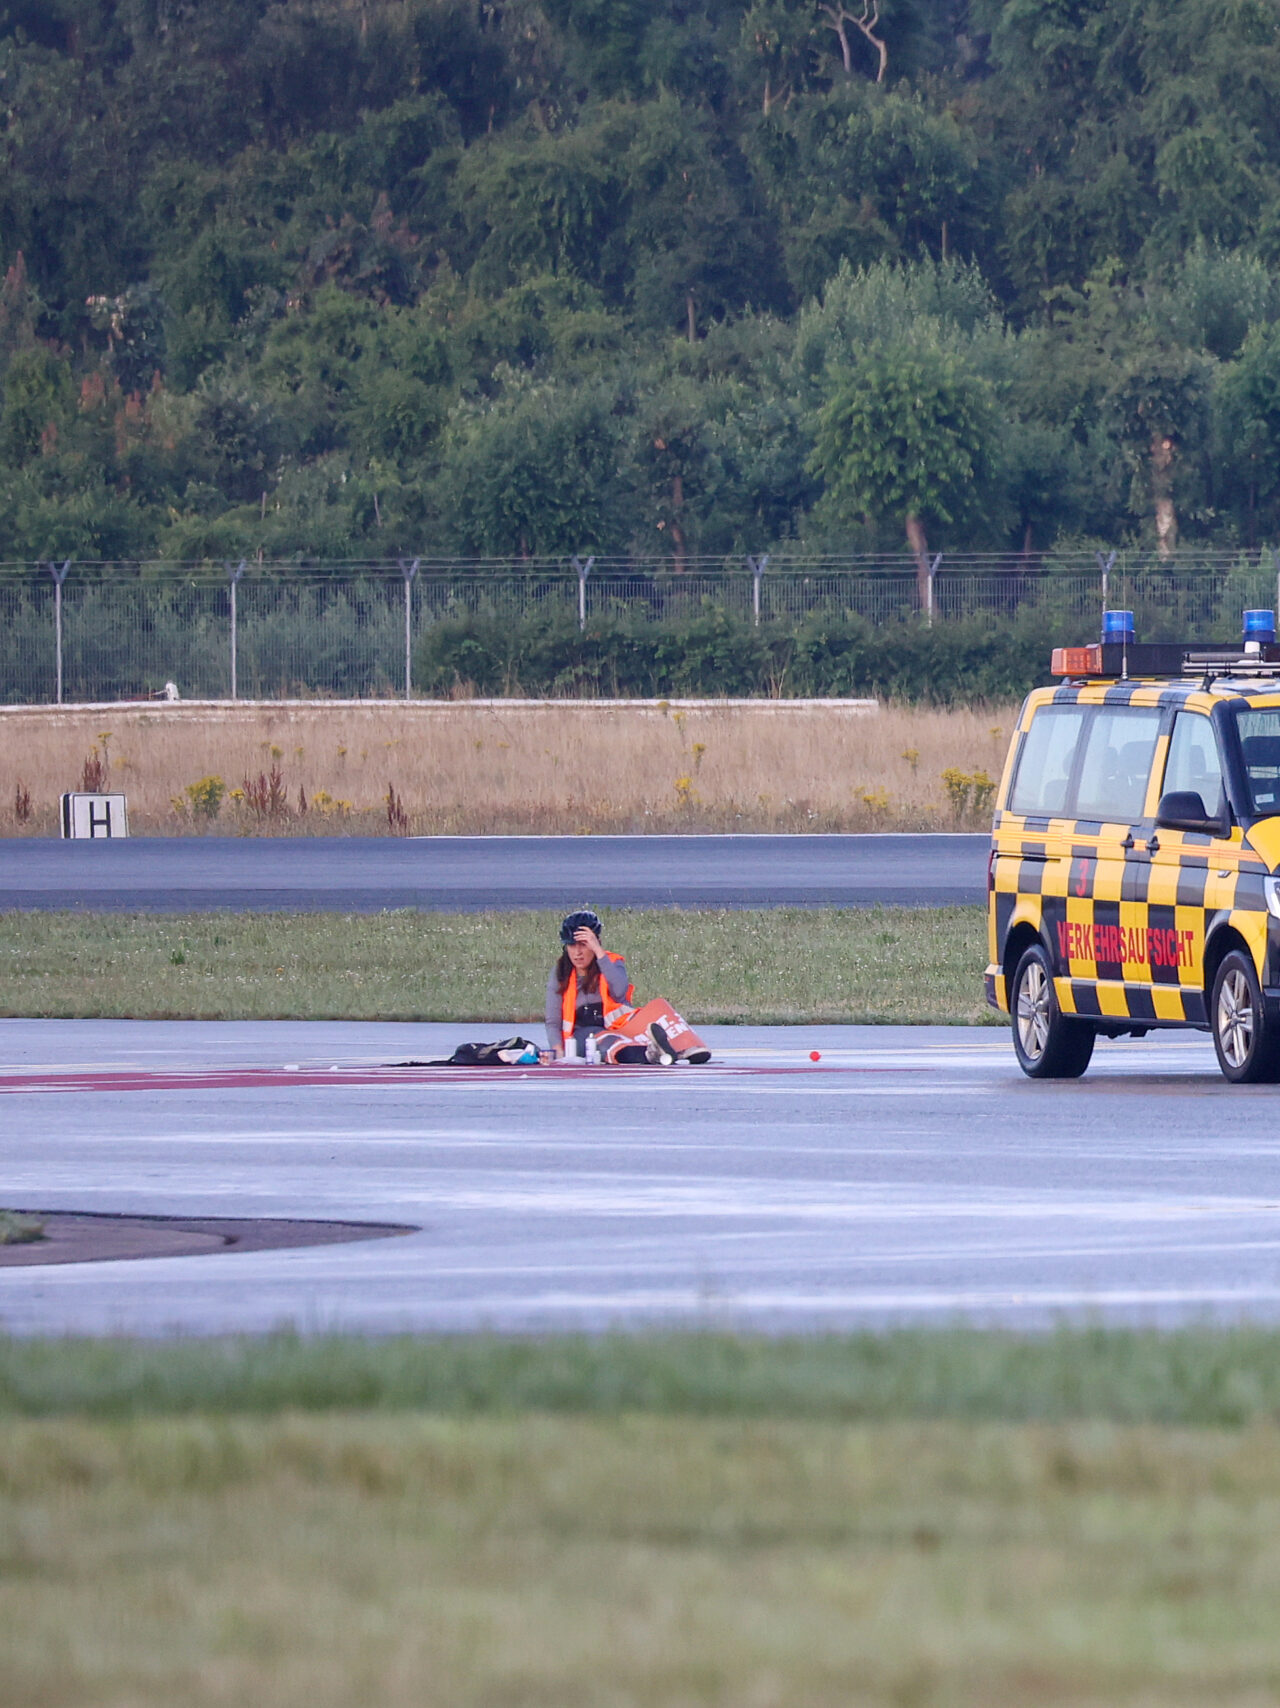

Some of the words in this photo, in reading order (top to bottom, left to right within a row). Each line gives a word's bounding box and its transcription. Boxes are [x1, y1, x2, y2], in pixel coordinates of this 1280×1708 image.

[90, 801, 111, 838] H
[1075, 858, 1091, 897] 3
[1057, 920, 1195, 968] VERKEHRSAUFSICHT
